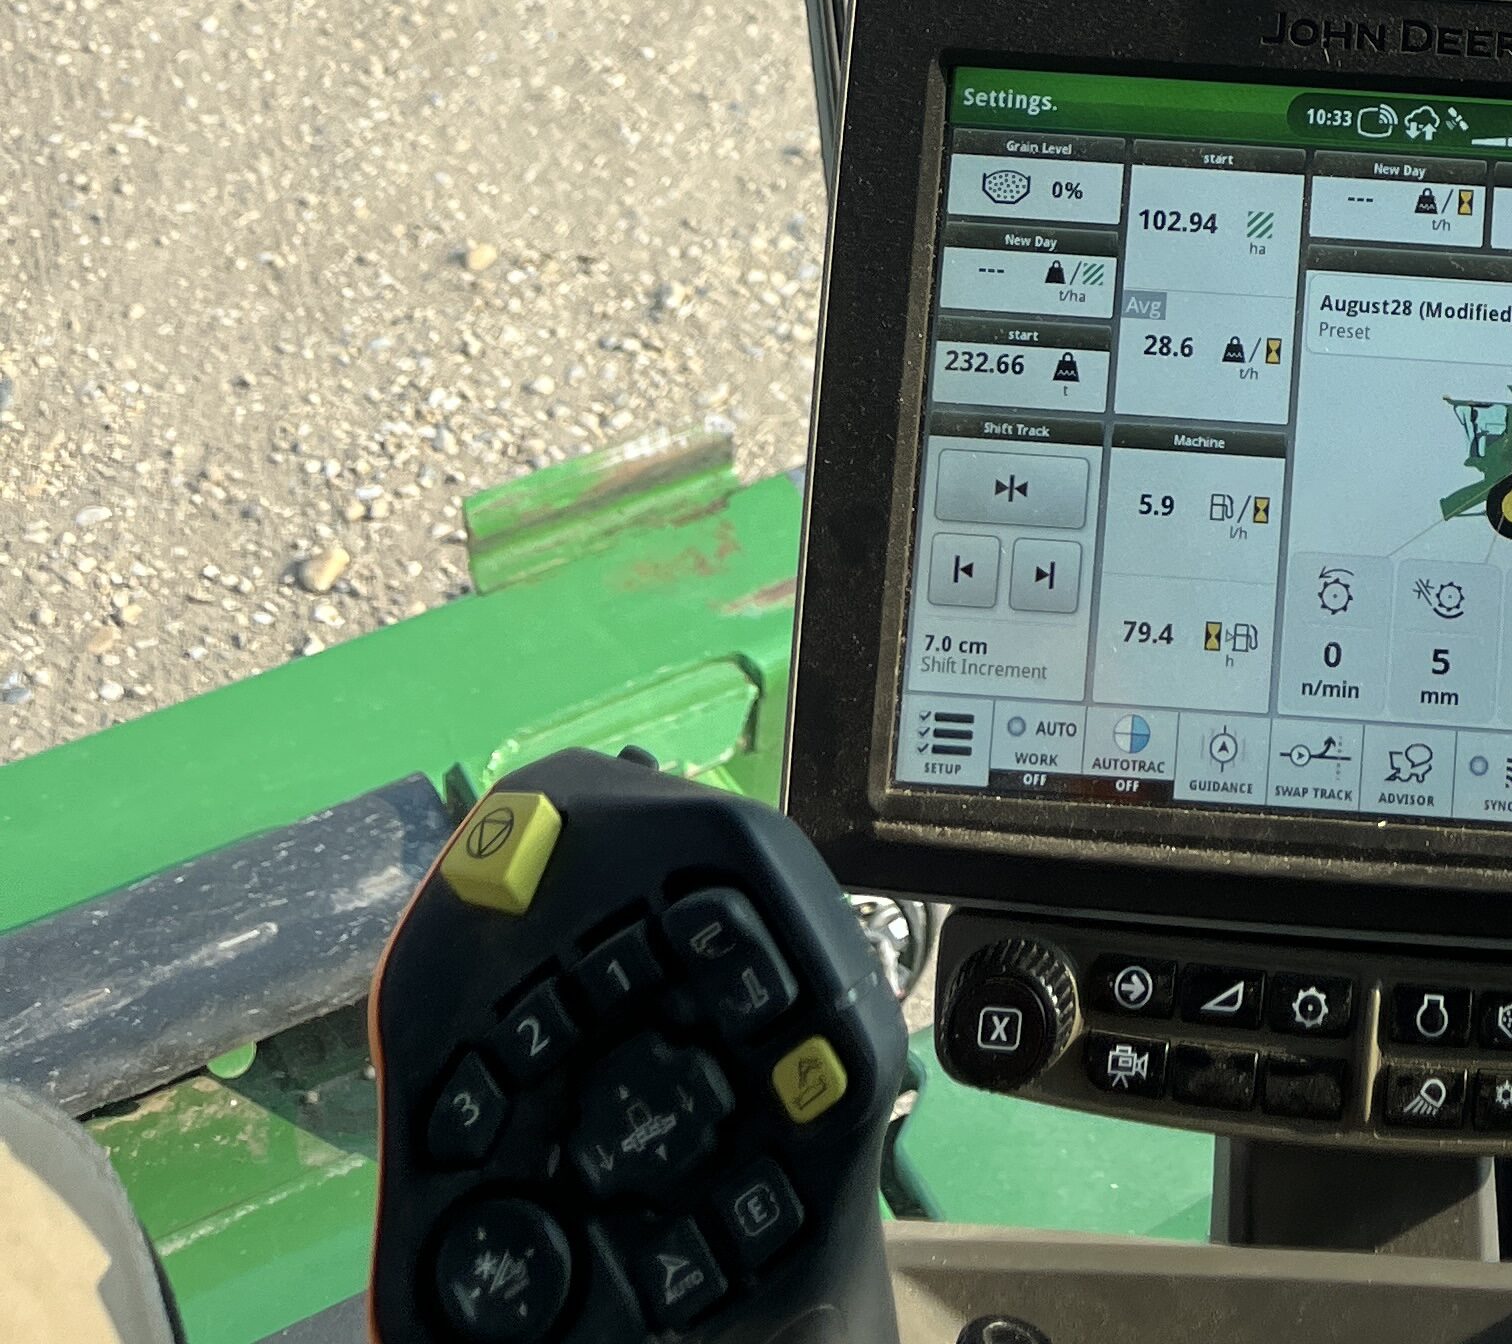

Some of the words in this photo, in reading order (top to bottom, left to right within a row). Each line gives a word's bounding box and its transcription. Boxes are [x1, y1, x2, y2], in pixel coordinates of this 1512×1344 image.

[1260, 11, 1386, 54] JOHN
[1306, 108, 1353, 128] 10:33
[1006, 140, 1039, 154] Grain
[1042, 142, 1073, 156] Level
[1203, 153, 1234, 165] start
[1373, 162, 1399, 176] New
[1403, 165, 1427, 180] Day
[1050, 180, 1084, 201] 0%
[1138, 208, 1219, 235] 102.94
[1431, 219, 1451, 232] t/h
[1005, 233, 1031, 248] New
[1034, 235, 1058, 252] Day
[1249, 242, 1267, 256] ha
[1058, 288, 1086, 303] t/ha
[1125, 296, 1162, 319] Avg
[1319, 294, 1413, 317] August28
[1008, 329, 1040, 342] start
[1318, 321, 1371, 340] Preset
[1143, 333, 1194, 359] 28.6
[944, 349, 1025, 376] 232.66
[1239, 367, 1259, 381] t/h
[983, 421, 1012, 436] Shift
[1016, 423, 1051, 438] Track
[1173, 434, 1226, 450] Machine
[1138, 493, 1176, 517] 5.9
[1122, 620, 1175, 645] 79.4
[924, 634, 952, 653] 7.0
[958, 638, 988, 655] cm
[1323, 641, 1342, 668] 0
[1431, 648, 1451, 675] 5
[920, 655, 956, 675] Shift
[960, 661, 1048, 680] Increment
[1301, 679, 1360, 700] n/min
[1420, 689, 1459, 706] mm
[1035, 721, 1078, 738] AUTO
[1014, 751, 1059, 767] WORK
[1091, 757, 1166, 774] AUTOTRAC
[924, 762, 962, 776] SETUP
[1022, 773, 1048, 787] OFF
[1115, 779, 1141, 792] OFF
[1189, 779, 1254, 795] GUIDANCE
[1274, 785, 1310, 800] SWAP
[1313, 787, 1353, 802] TRACK
[1378, 792, 1435, 807] ADVISOR
[606, 958, 634, 993] 1
[516, 1015, 552, 1057] 2
[990, 1015, 1010, 1042] X
[451, 1089, 480, 1128] 3
